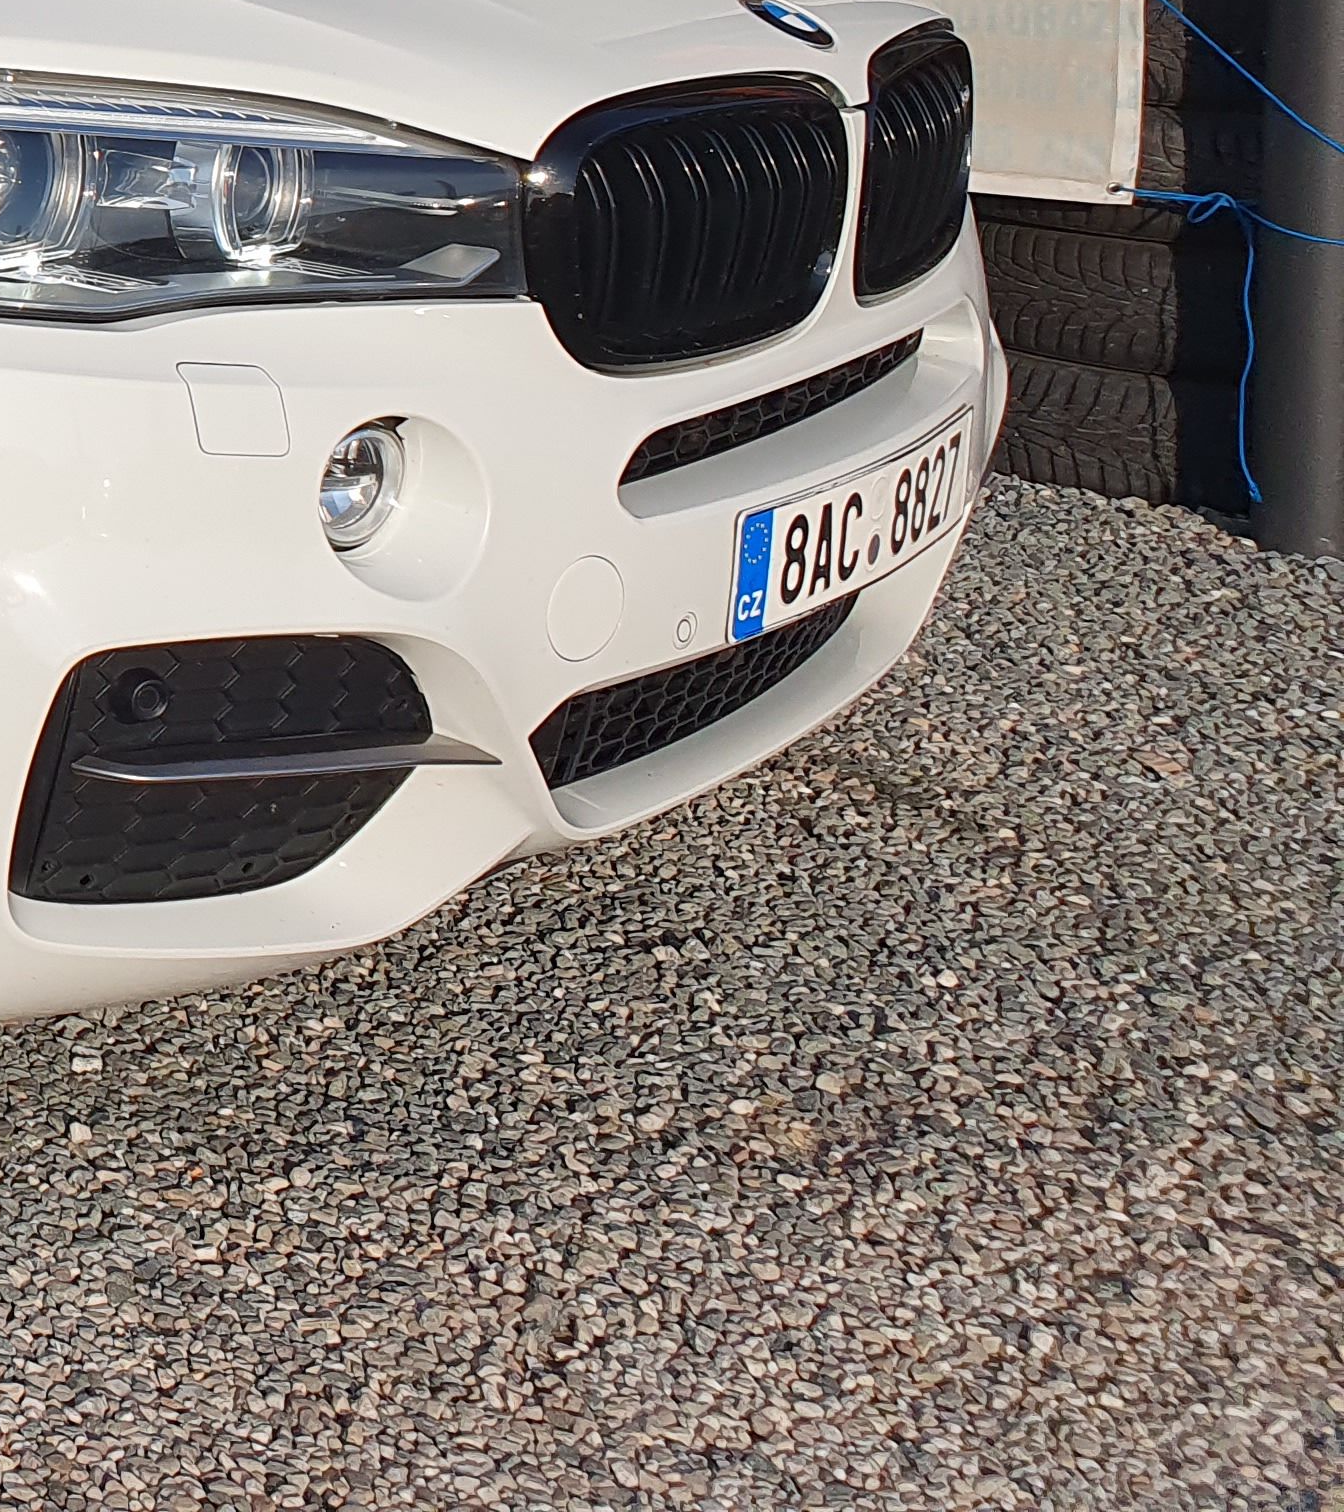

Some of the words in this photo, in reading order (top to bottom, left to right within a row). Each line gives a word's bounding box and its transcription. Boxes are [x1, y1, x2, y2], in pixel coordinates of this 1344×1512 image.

[781, 491, 863, 605] 8AC
[890, 430, 962, 555] 8827
[737, 589, 764, 622] CZ
